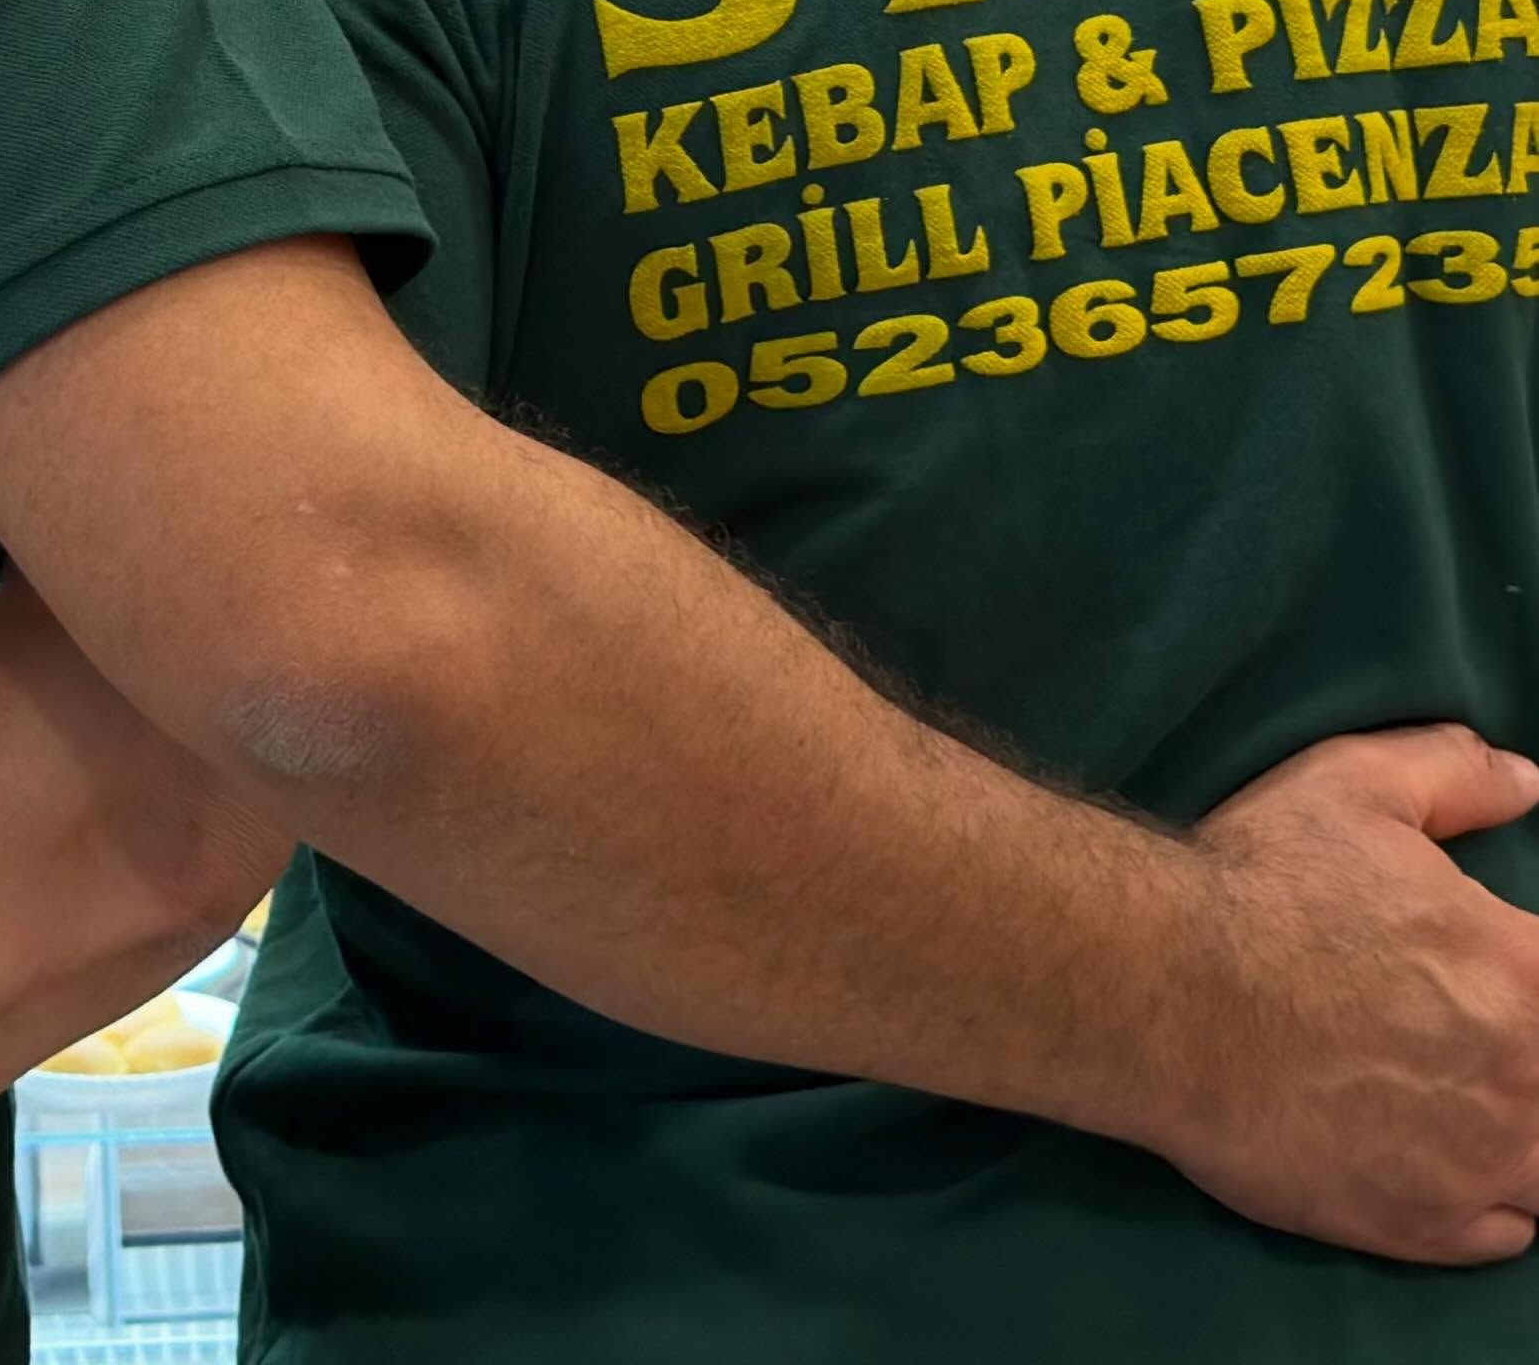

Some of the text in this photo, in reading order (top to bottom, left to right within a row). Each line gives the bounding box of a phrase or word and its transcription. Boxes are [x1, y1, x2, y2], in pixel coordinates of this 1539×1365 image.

[611, 32, 1035, 214] KEBAP
[1073, 14, 1169, 114] &
[640, 229, 1539, 434] 052365723
